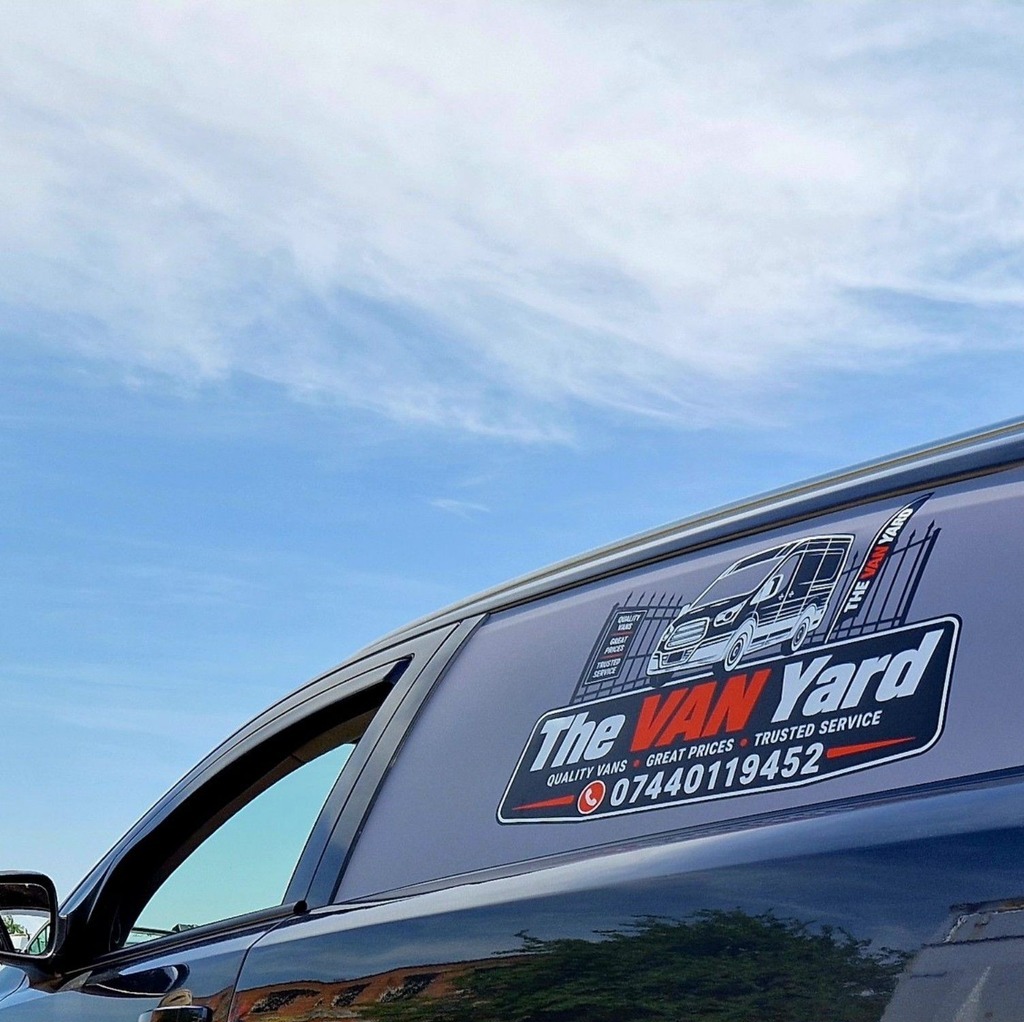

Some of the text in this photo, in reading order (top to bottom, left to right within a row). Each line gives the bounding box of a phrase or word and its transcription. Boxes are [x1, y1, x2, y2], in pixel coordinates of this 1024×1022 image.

[843, 508, 914, 613] THE VAN YARD
[617, 614, 641, 623] QUALITY
[609, 636, 629, 645] GREAT
[603, 645, 625, 654] PRICES
[596, 658, 621, 669] TRUSTED
[592, 666, 617, 678] SERVICE
[530, 628, 945, 772] The VAN Yard
[546, 710, 884, 787] QUALITY VANS GREAT PRICES TRUSTED SERVICE
[610, 742, 824, 807] 07440119452
